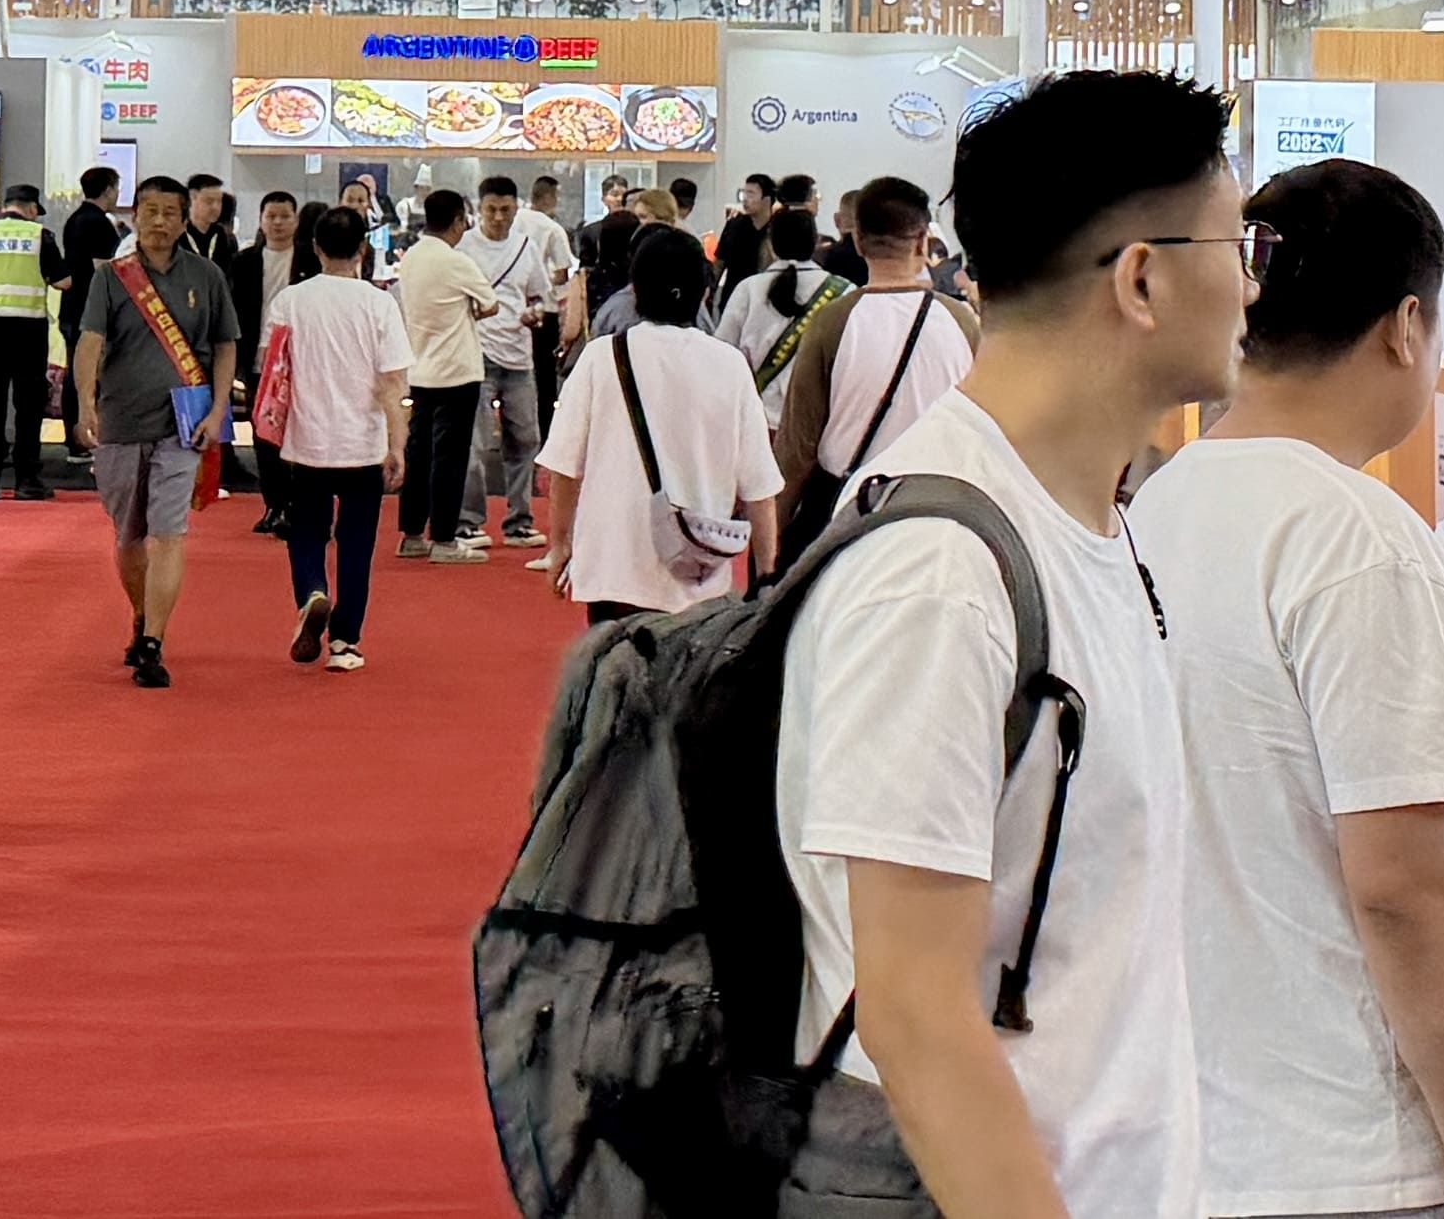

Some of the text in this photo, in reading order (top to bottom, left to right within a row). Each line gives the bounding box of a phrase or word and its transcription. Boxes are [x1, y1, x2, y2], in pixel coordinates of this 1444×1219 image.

[539, 37, 598, 61] BEEF
[104, 59, 150, 82] 牛肉
[118, 103, 158, 119] BEEF
[792, 108, 858, 126] Argentina
[1279, 132, 1323, 152] 2082
